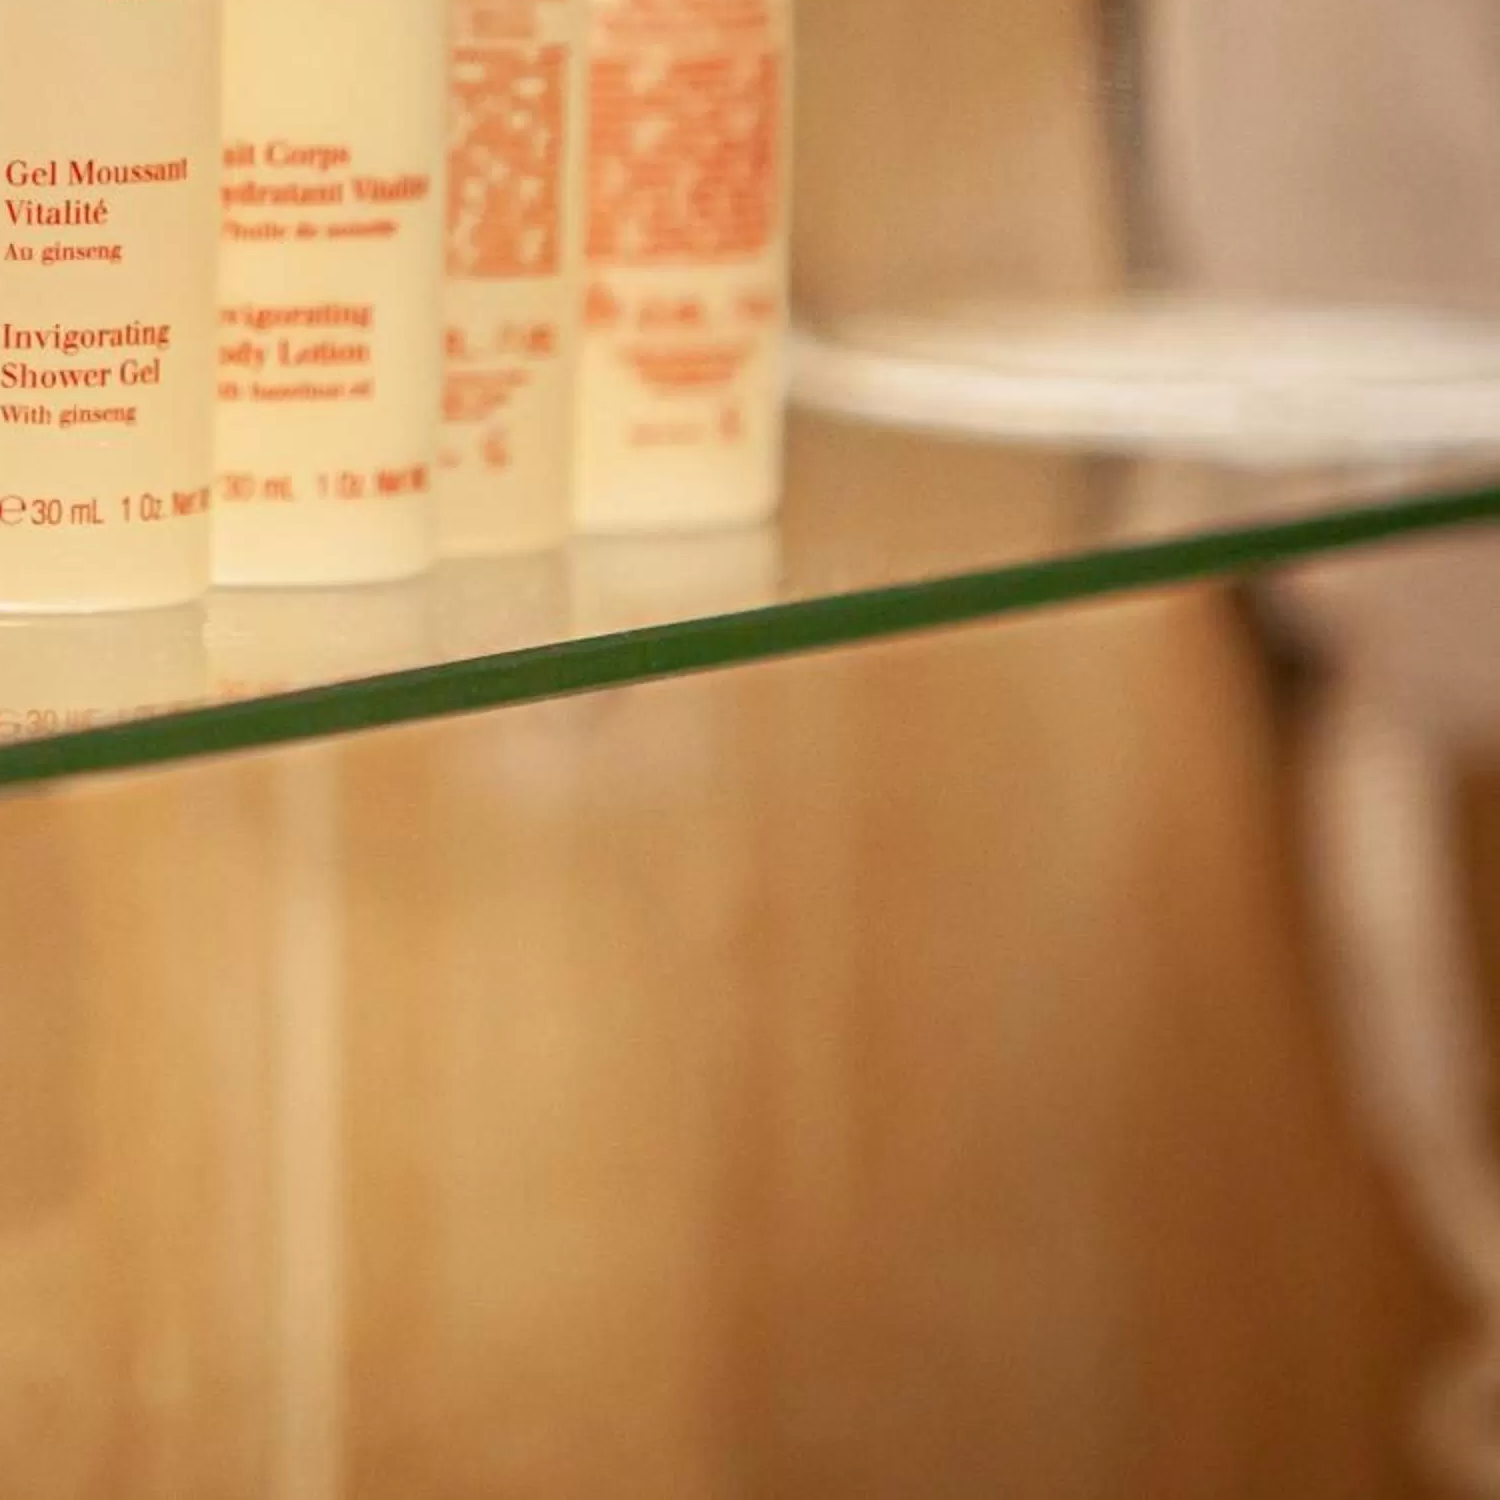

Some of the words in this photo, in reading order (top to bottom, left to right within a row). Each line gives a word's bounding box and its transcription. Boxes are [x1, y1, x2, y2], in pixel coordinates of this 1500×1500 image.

[4, 158, 59, 187] Gel
[68, 156, 188, 187] Moussant
[3, 198, 108, 227] Vitalité
[3, 242, 34, 262] Au
[40, 241, 123, 267] ginseng
[2, 319, 171, 357] Invigorating
[277, 337, 373, 368] Lotion
[0, 361, 112, 390] Shower
[118, 357, 161, 387] Gel
[0, 403, 53, 427] With
[58, 403, 138, 429] ginseng
[69, 497, 106, 526] mL
[121, 495, 132, 525] 1
